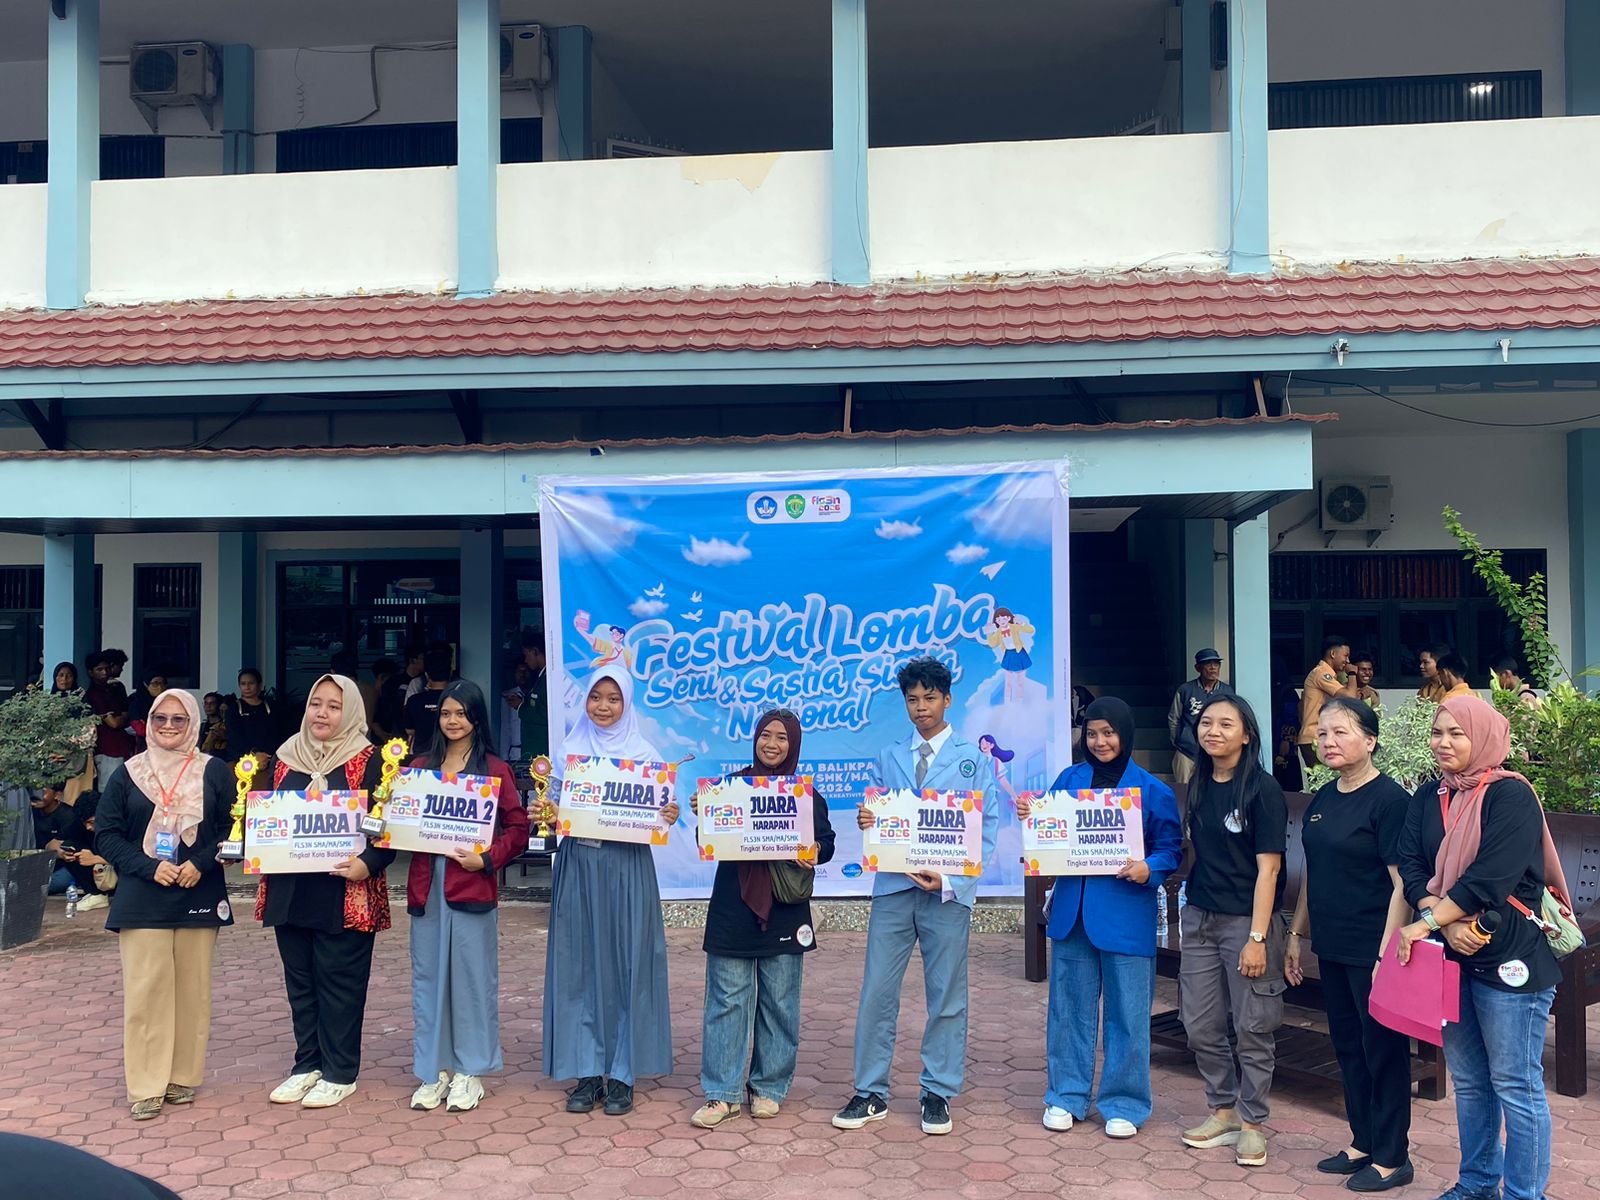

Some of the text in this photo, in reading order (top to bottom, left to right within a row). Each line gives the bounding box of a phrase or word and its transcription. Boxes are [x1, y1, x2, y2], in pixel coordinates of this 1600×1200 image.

[624, 593, 826, 680] Festival
[826, 584, 996, 658] Lomba
[644, 666, 719, 708] Seni
[716, 675, 739, 709] &
[740, 657, 848, 706] Sastra
[818, 762, 874, 772] BALIKPA
[818, 783, 852, 793] 2026
[571, 793, 600, 803] 2026
[602, 781, 669, 807] JUARA 3
[423, 794, 494, 820] JUARA 2
[750, 796, 797, 814] JUARA
[391, 806, 419, 816] 2026
[293, 813, 350, 834] JUARA
[714, 817, 743, 826] 2026
[917, 809, 966, 828] JUARA
[1076, 809, 1126, 828] JUARA
[598, 818, 617, 827] Tingkat
[632, 822, 663, 831] Balikpapan
[753, 820, 789, 830] HARAPAN
[256, 829, 288, 838] 2026
[419, 832, 439, 840] Tingkat
[454, 835, 486, 844] Balikpapan
[880, 829, 910, 838] 2026
[1037, 830, 1067, 839] 2026
[1078, 833, 1117, 844] HARAPAN
[1119, 834, 1124, 844] 3
[918, 833, 956, 844] HARAPAN
[958, 835, 963, 845] 2
[740, 845, 760, 853] Tingkat
[776, 844, 808, 852] Balikpapan
[289, 851, 310, 859] Tingkat
[905, 858, 975, 867] Tingkat Kota Balikpapan
[1067, 860, 1087, 868] Tingkat
